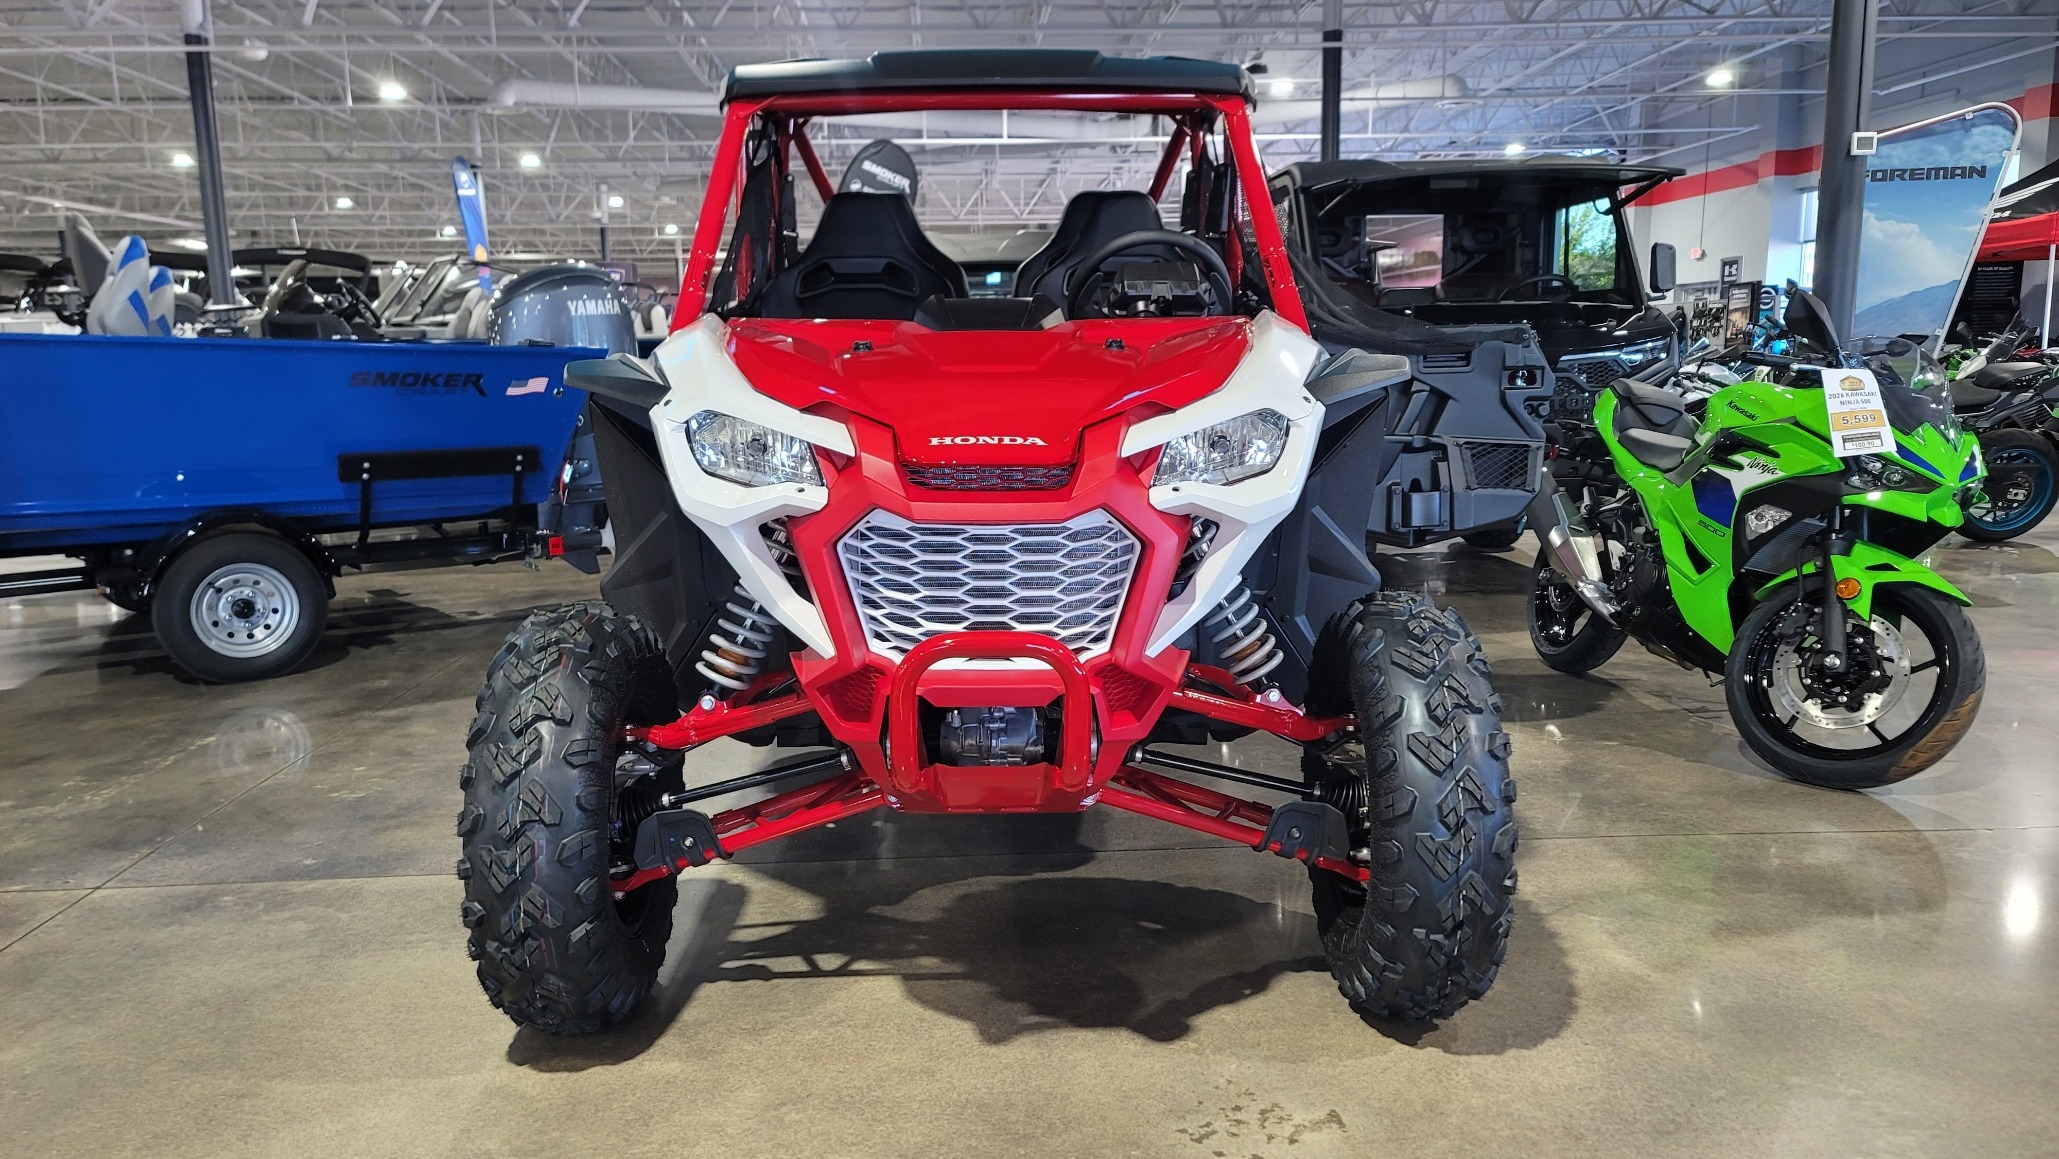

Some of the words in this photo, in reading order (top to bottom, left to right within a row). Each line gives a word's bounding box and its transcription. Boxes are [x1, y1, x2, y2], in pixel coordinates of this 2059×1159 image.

[861, 160, 911, 194] SMOKER
[567, 300, 621, 315] YAMAHA
[350, 371, 488, 397] SMOKER
[1726, 400, 1760, 421] Kawasaki
[1842, 414, 1876, 425] 5,599
[928, 436, 1049, 446] HONDA
[1746, 456, 1779, 475] Ninja
[1698, 519, 1726, 537] 500
